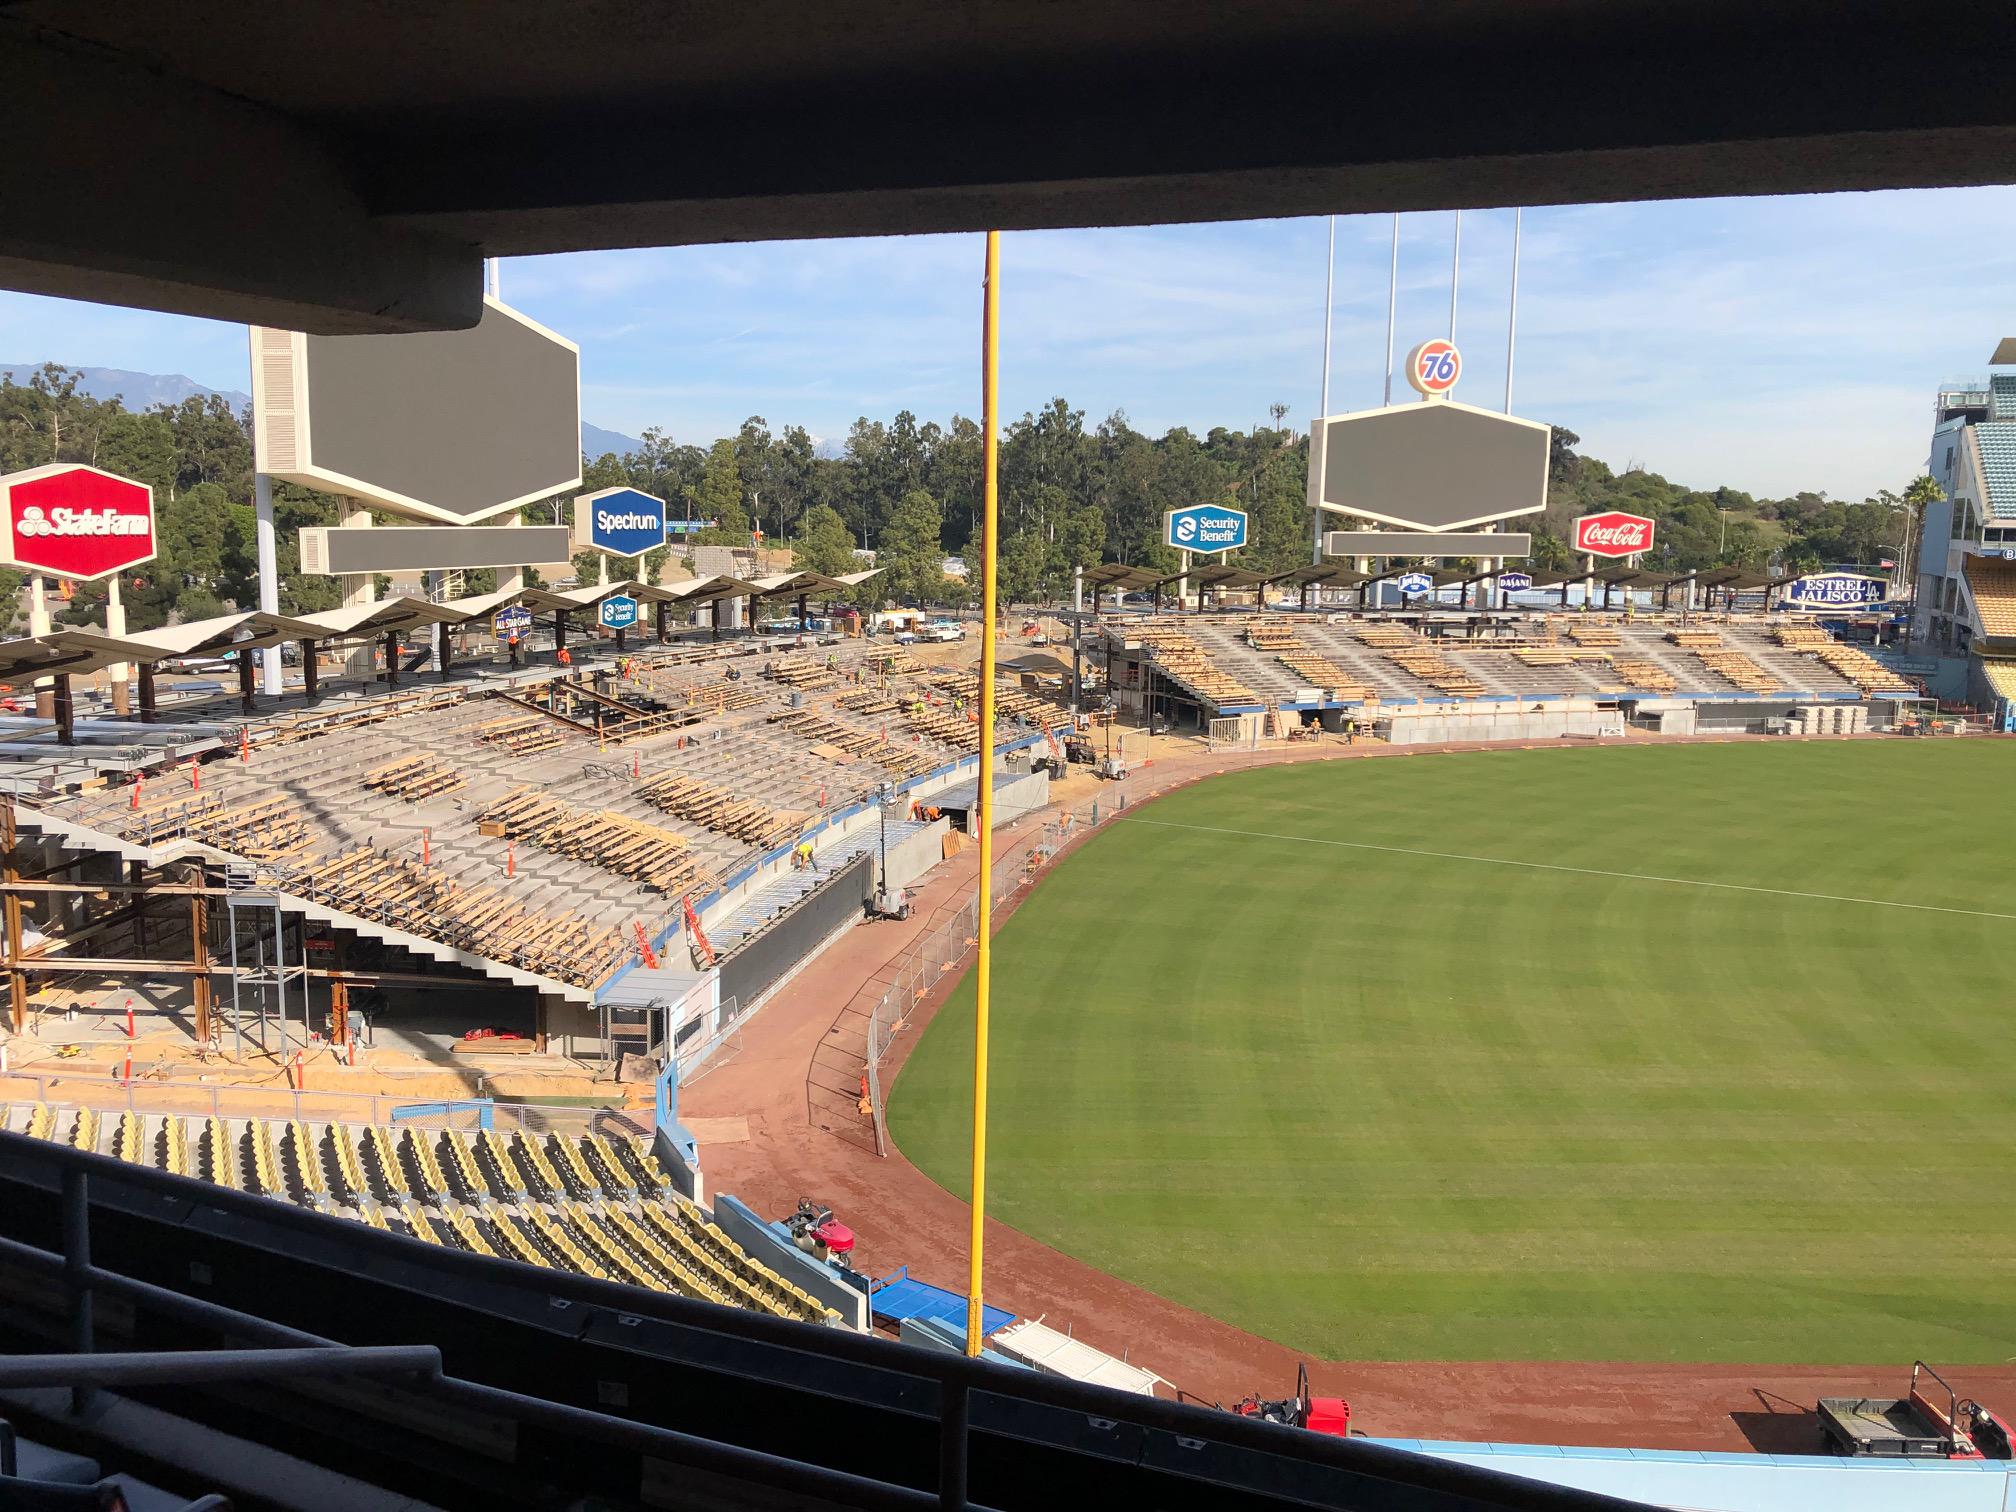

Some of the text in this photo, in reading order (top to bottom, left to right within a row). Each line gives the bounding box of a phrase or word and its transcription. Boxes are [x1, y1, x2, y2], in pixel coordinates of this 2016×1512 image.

[1423, 351, 1454, 381] 76
[597, 510, 657, 534] Spectrum
[1200, 516, 1240, 531] Security
[1200, 530, 1236, 541] Benefit
[1500, 579, 1530, 588] DASANI
[1804, 579, 1865, 591] ESTREL
[1797, 590, 1862, 602] JALISCO
[614, 603, 634, 613] Security
